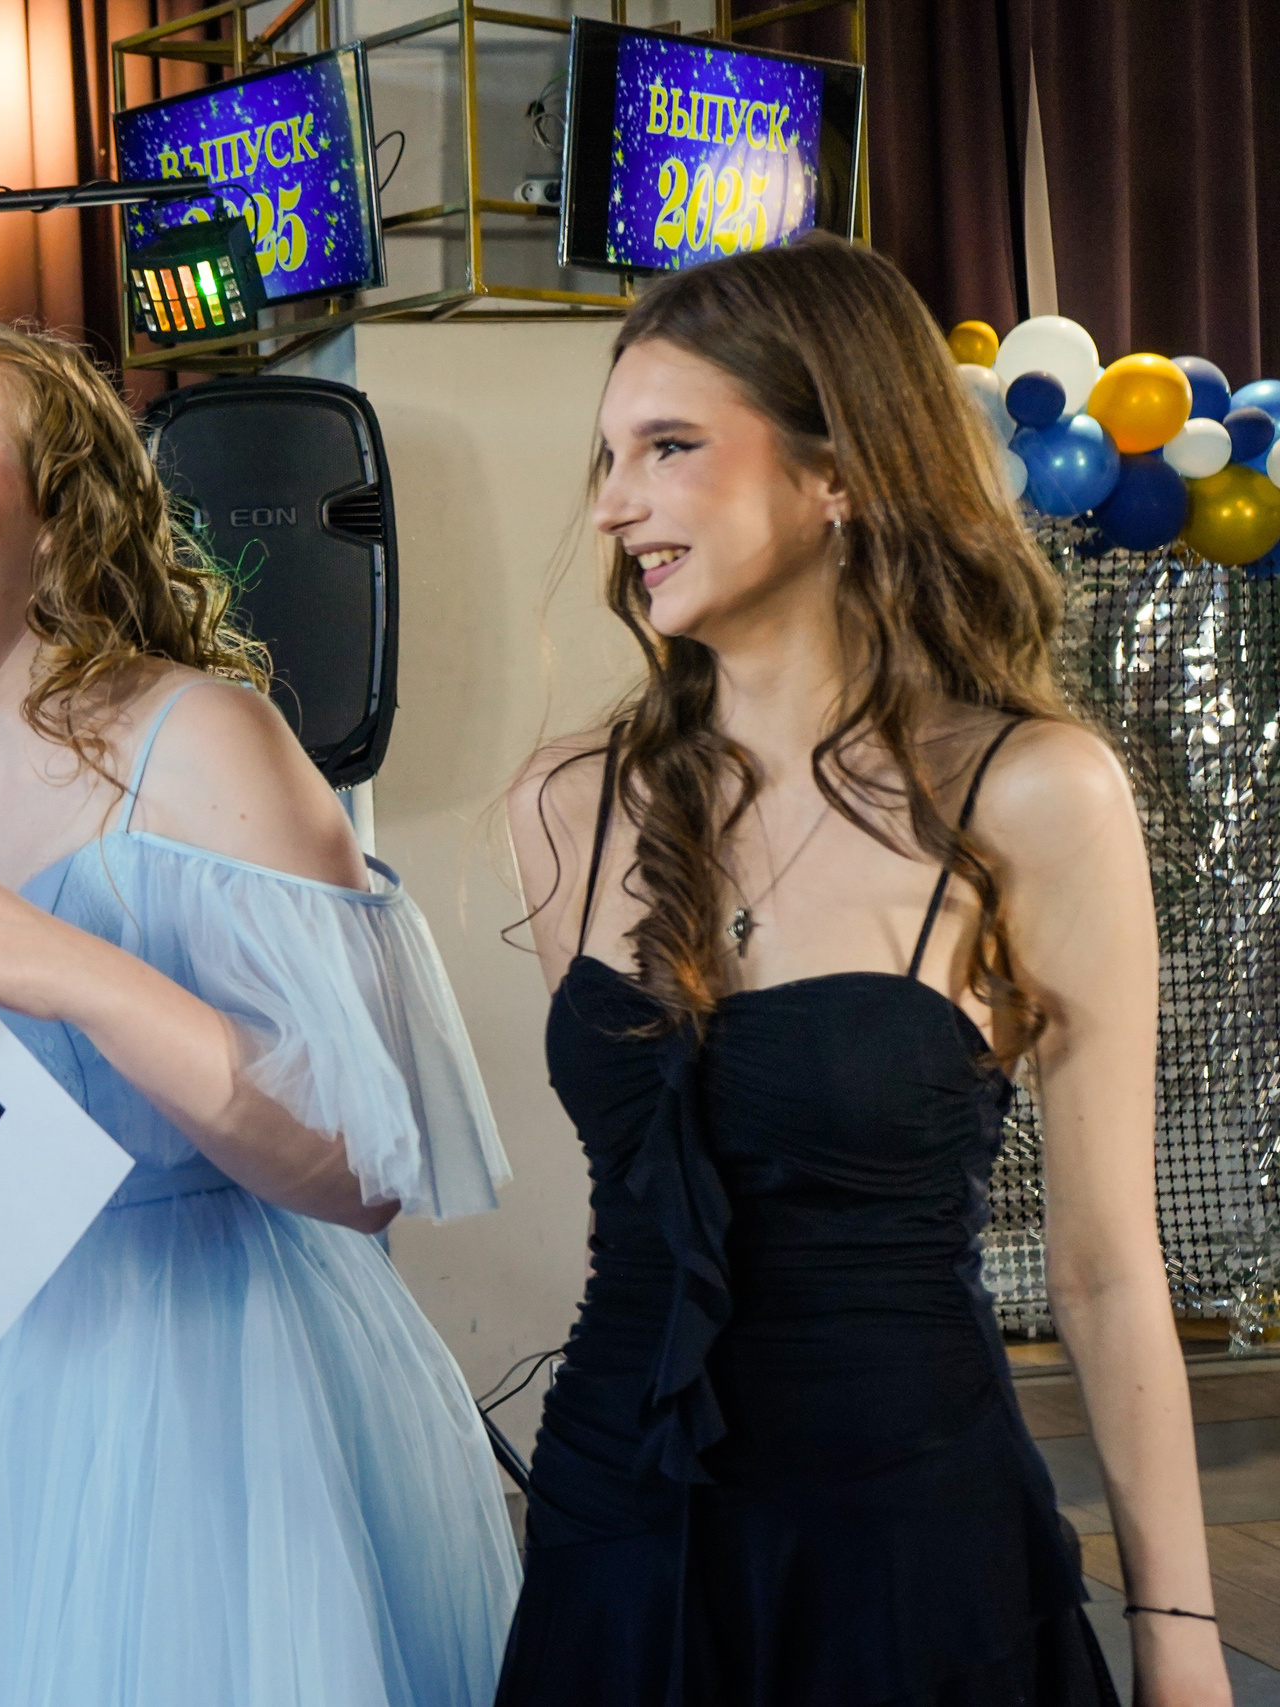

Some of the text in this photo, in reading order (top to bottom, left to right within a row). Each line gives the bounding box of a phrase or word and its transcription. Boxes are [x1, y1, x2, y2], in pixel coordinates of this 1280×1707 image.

[646, 84, 790, 154] ВЫПУСК
[653, 156, 771, 256] 2025
[229, 507, 298, 528] EON
